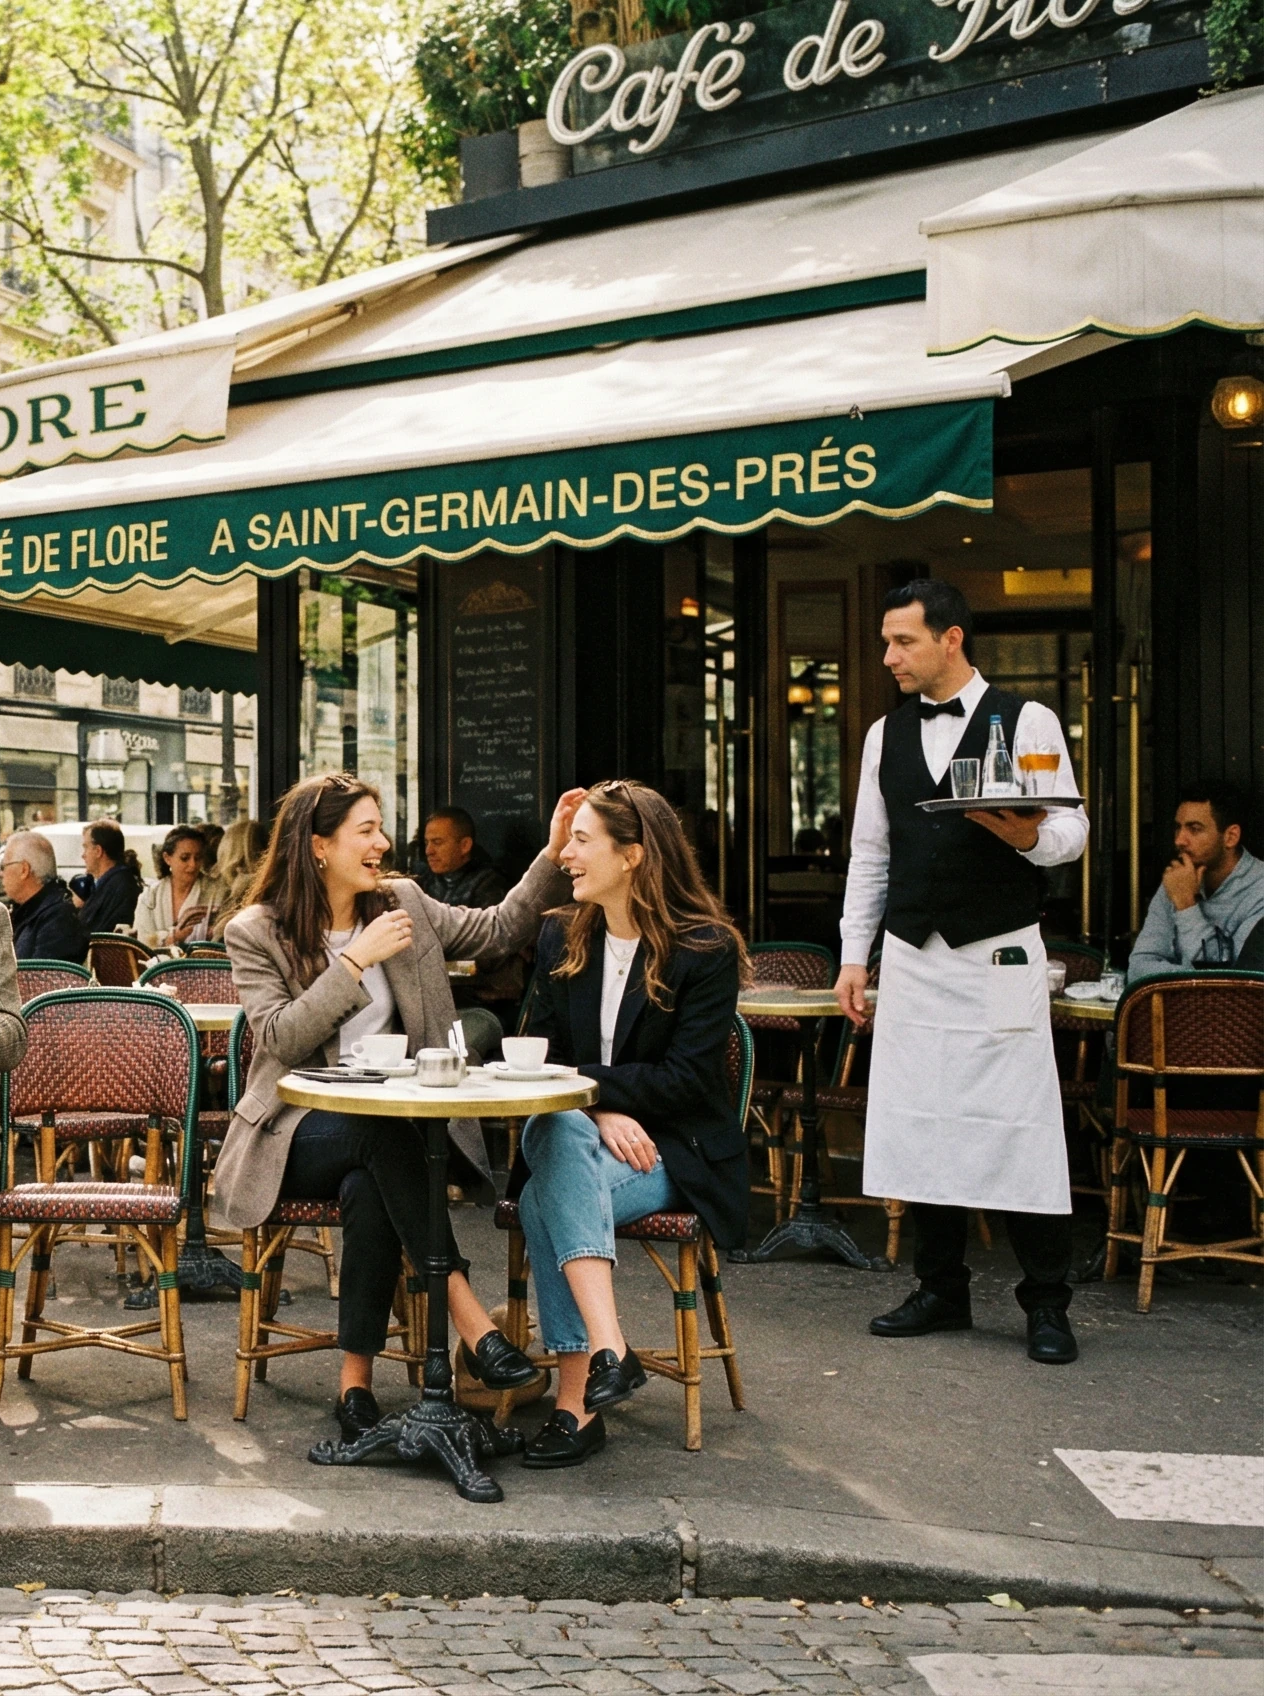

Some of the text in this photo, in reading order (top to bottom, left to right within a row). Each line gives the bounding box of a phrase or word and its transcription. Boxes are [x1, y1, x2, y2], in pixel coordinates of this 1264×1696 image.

[546, 21, 756, 154] Café
[783, 0, 887, 92] de
[22, 532, 61, 575] DE
[71, 519, 169, 570] FLORE
[209, 518, 236, 556] A
[247, 436, 877, 551] SAINT-GERMAIN-DES-PRÉS
